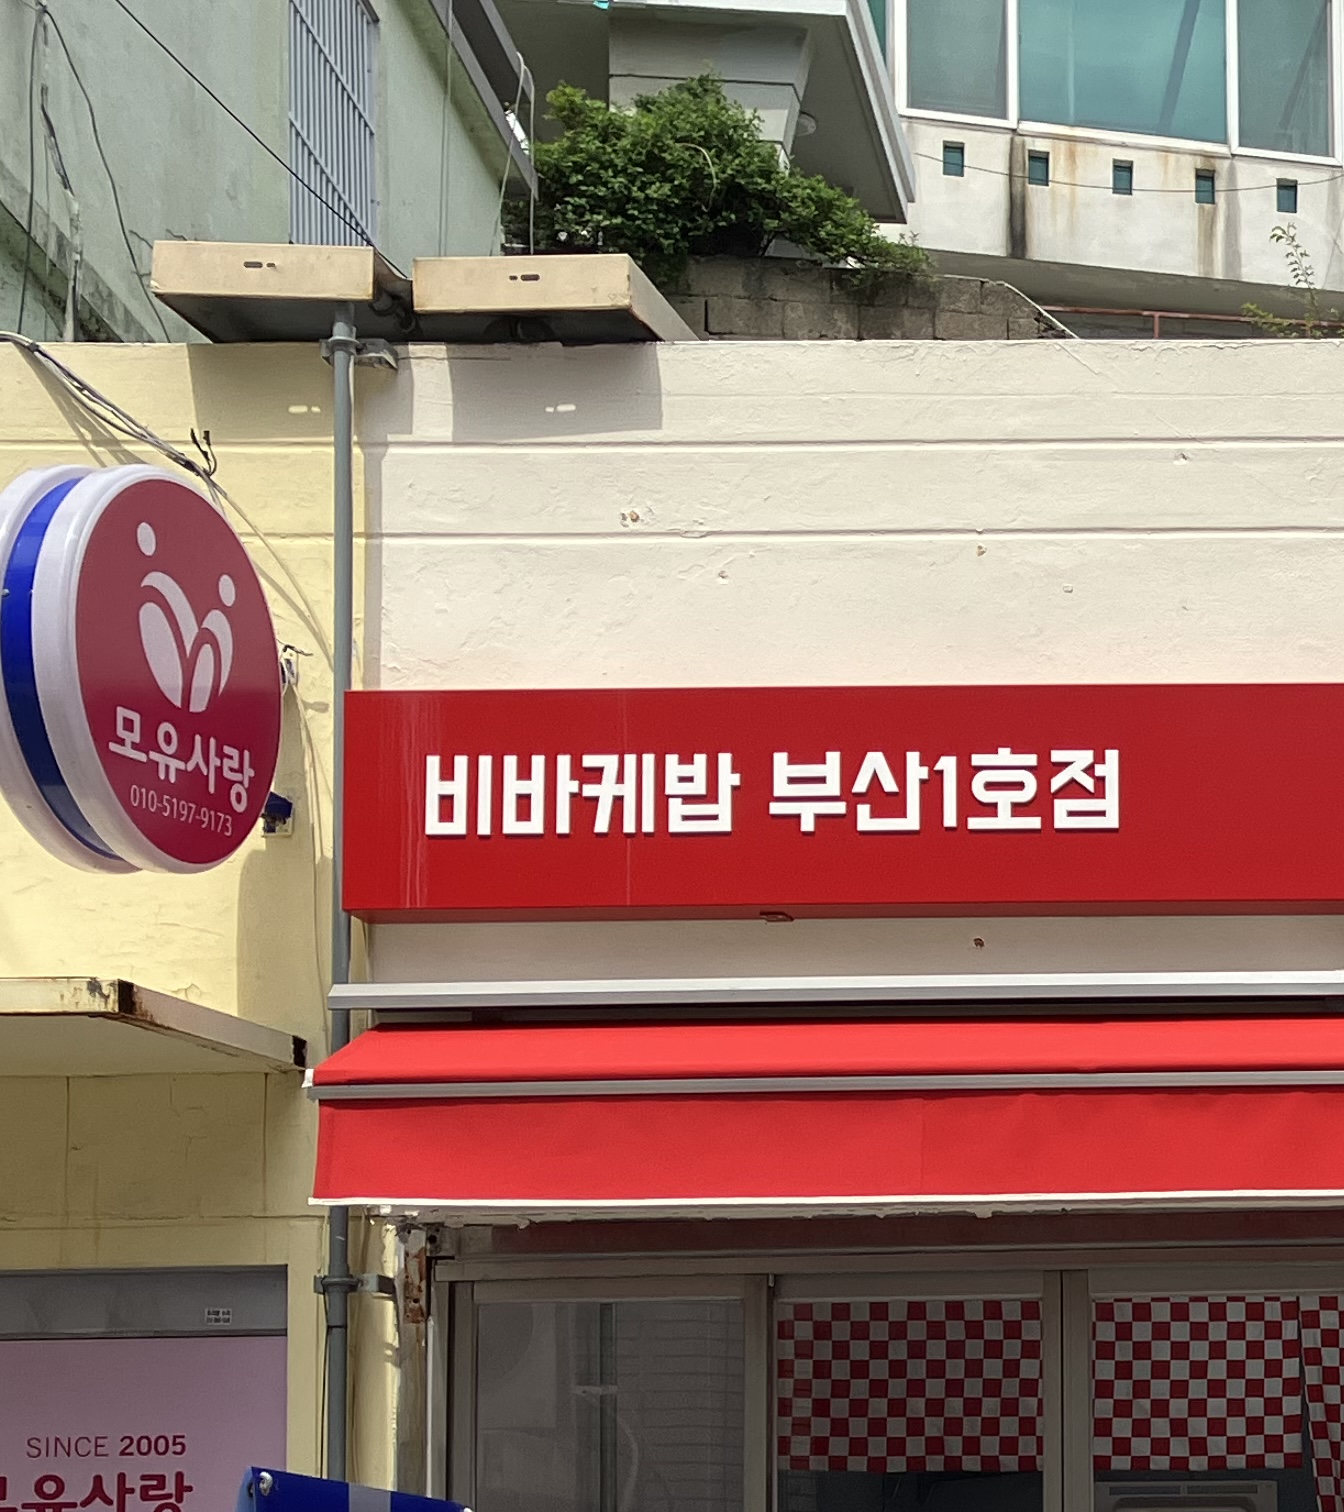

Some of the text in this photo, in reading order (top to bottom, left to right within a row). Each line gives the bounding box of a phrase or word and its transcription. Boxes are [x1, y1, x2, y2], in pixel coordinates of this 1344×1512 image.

[109, 706, 255, 813] 모유사랑
[425, 747, 1120, 836] 비바케밥 부산1호점
[130, 784, 233, 837] 010-5197-9173
[26, 1435, 187, 1458] SINCE 2005
